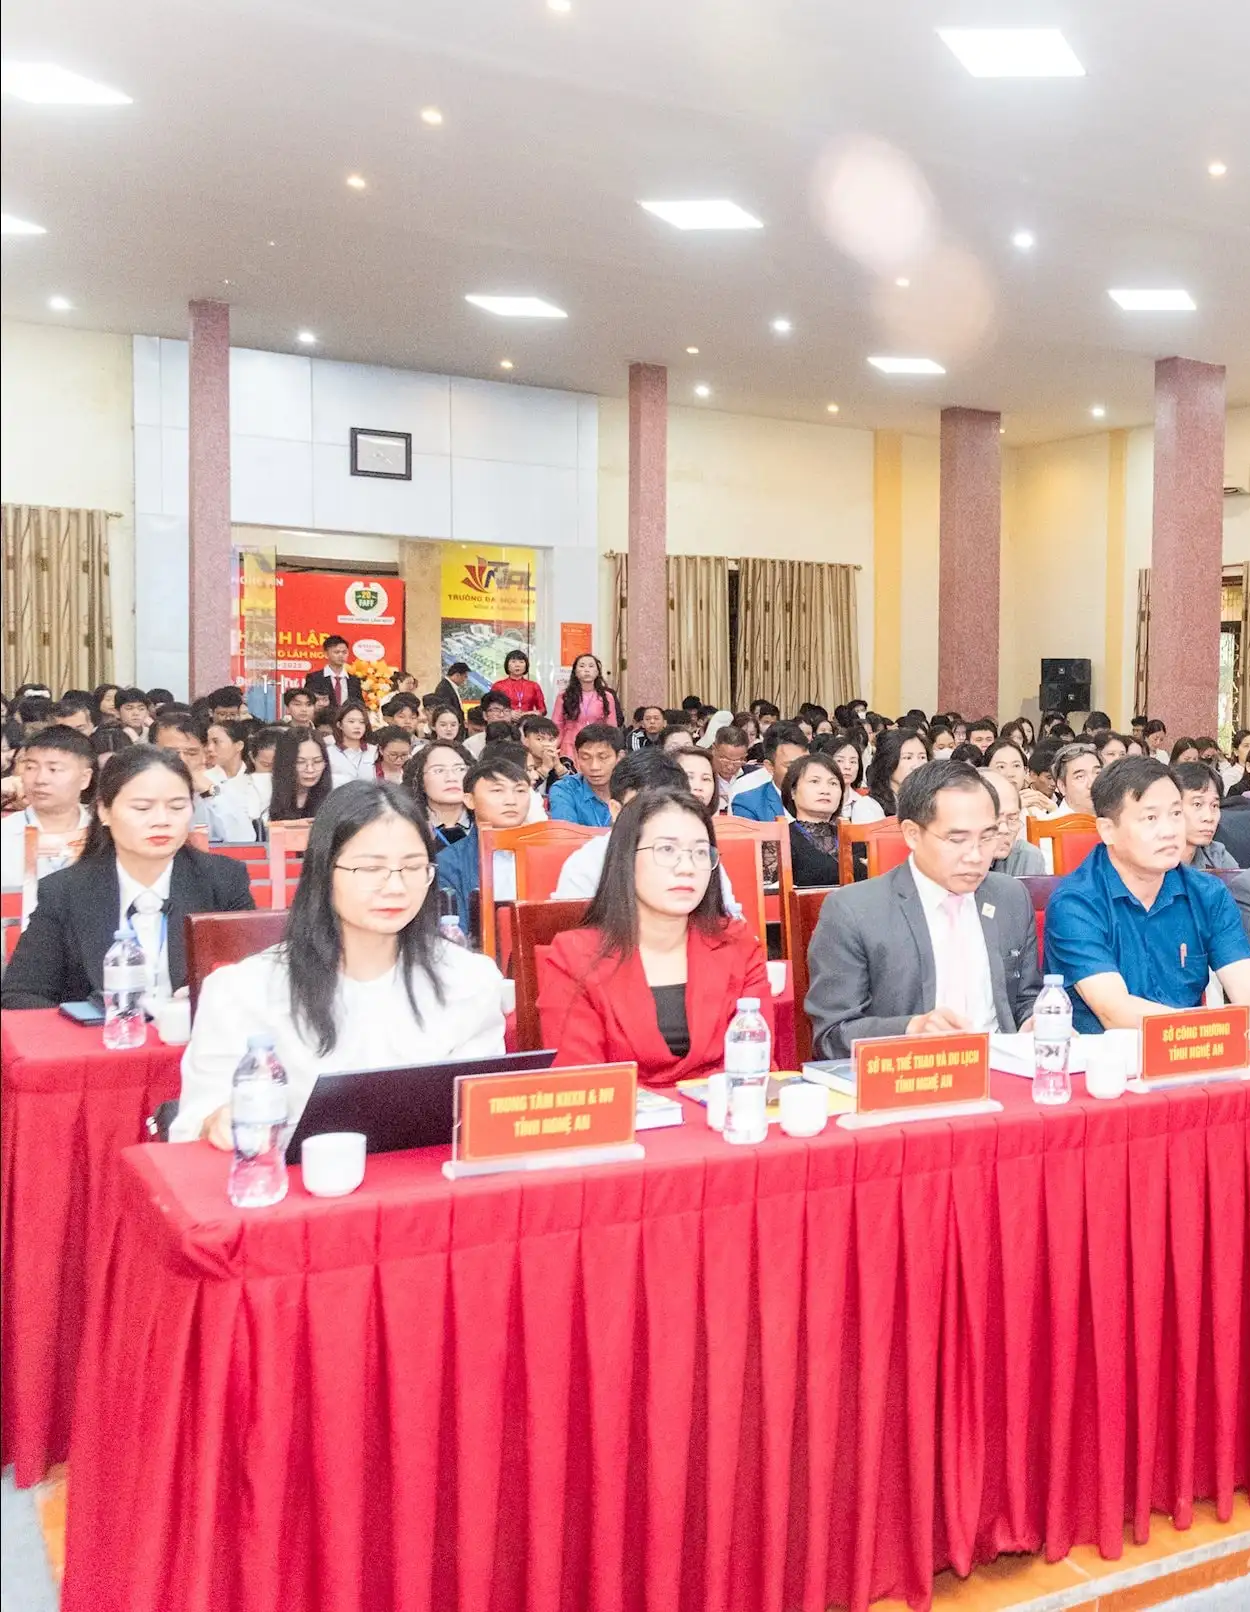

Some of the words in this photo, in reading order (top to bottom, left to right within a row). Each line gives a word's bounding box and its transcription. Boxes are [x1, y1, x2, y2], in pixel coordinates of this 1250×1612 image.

[361, 591, 372, 599] 20
[448, 593, 482, 602] TRƯỜNG
[1162, 1024, 1174, 1042] SỞ
[1175, 1024, 1198, 1041] CÔNG
[1199, 1022, 1231, 1038] THƯƠNG
[867, 1055, 880, 1074] SỞ
[896, 1051, 913, 1072] THỂ
[914, 1054, 934, 1069] THAO
[936, 1050, 947, 1067] VÀ
[948, 1052, 960, 1065] DU
[961, 1050, 979, 1067] LỊCH
[1168, 1044, 1188, 1062] TỈNH
[1189, 1042, 1211, 1060] NGHỆ
[1212, 1042, 1224, 1056] AN
[895, 1074, 915, 1093] TỈNH
[915, 1072, 939, 1092] NGHỆ
[940, 1074, 953, 1088] AN
[489, 1094, 528, 1114] TRUNG
[529, 1090, 554, 1111] TÂM
[588, 1090, 597, 1105] &
[513, 1116, 540, 1137] TỈNH
[541, 1113, 572, 1135] NGHỆ
[574, 1114, 590, 1131] AN
